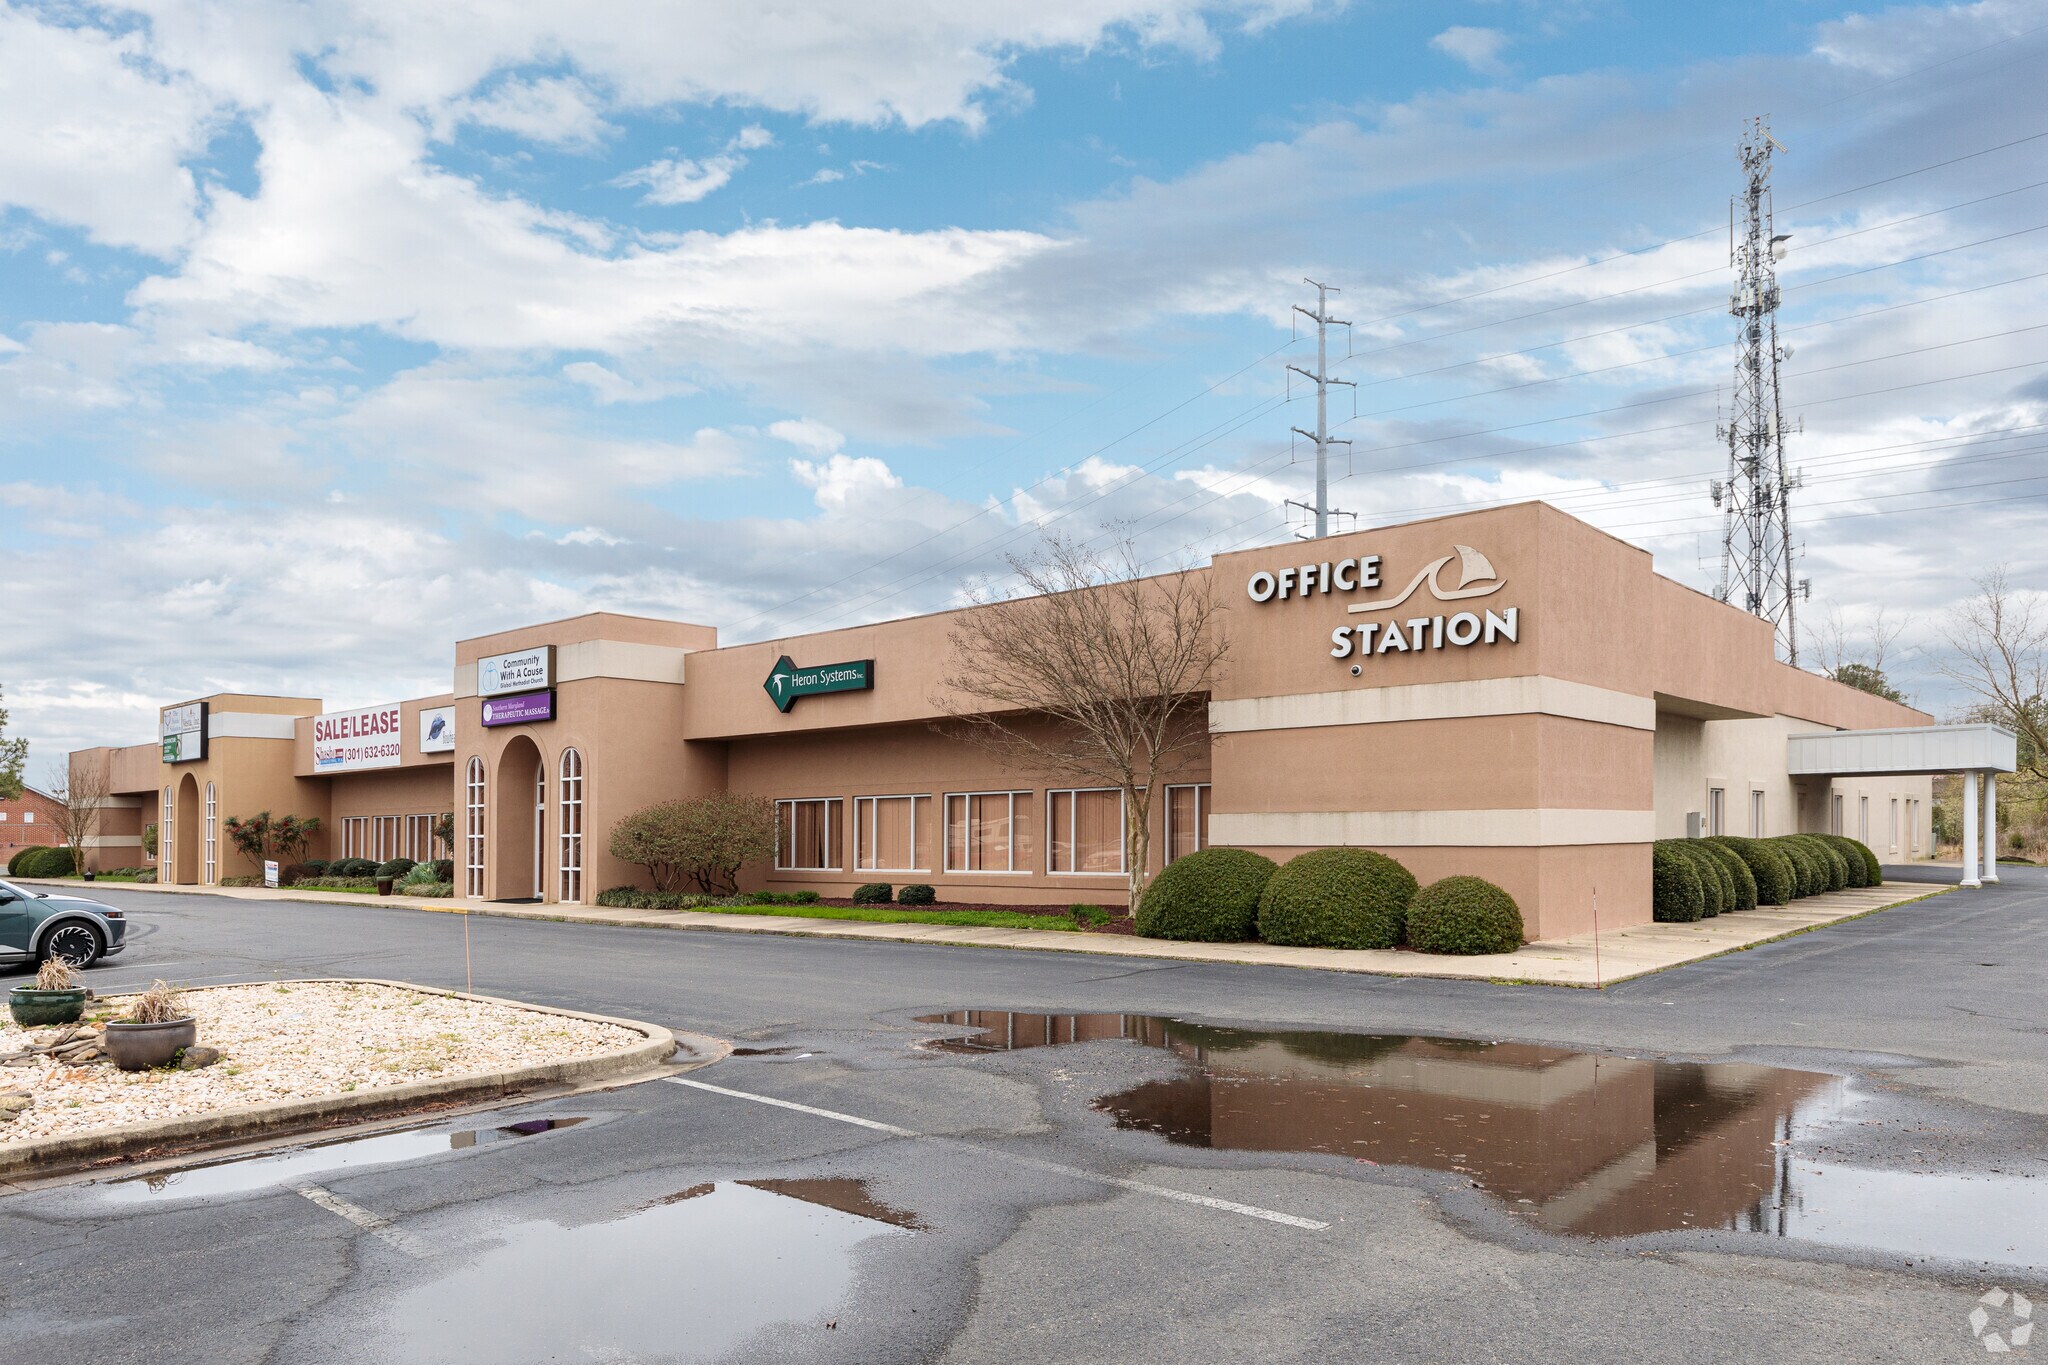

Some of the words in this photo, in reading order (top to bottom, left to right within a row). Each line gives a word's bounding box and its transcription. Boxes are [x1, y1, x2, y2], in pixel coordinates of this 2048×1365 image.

[1247, 554, 1382, 602] OFFICE
[1330, 607, 1520, 659] STATION
[504, 654, 540, 669] Community
[500, 671, 514, 680] With
[516, 669, 521, 678] A
[523, 667, 543, 677] Cause
[791, 673, 818, 687] Heron
[820, 669, 857, 686] Systems
[492, 709, 524, 720] THERAPEUTIC
[524, 706, 547, 716] MASSAGE
[316, 710, 398, 742] SALE/LEASE
[344, 747, 363, 763] (301)
[364, 743, 400, 759] 632-6320
